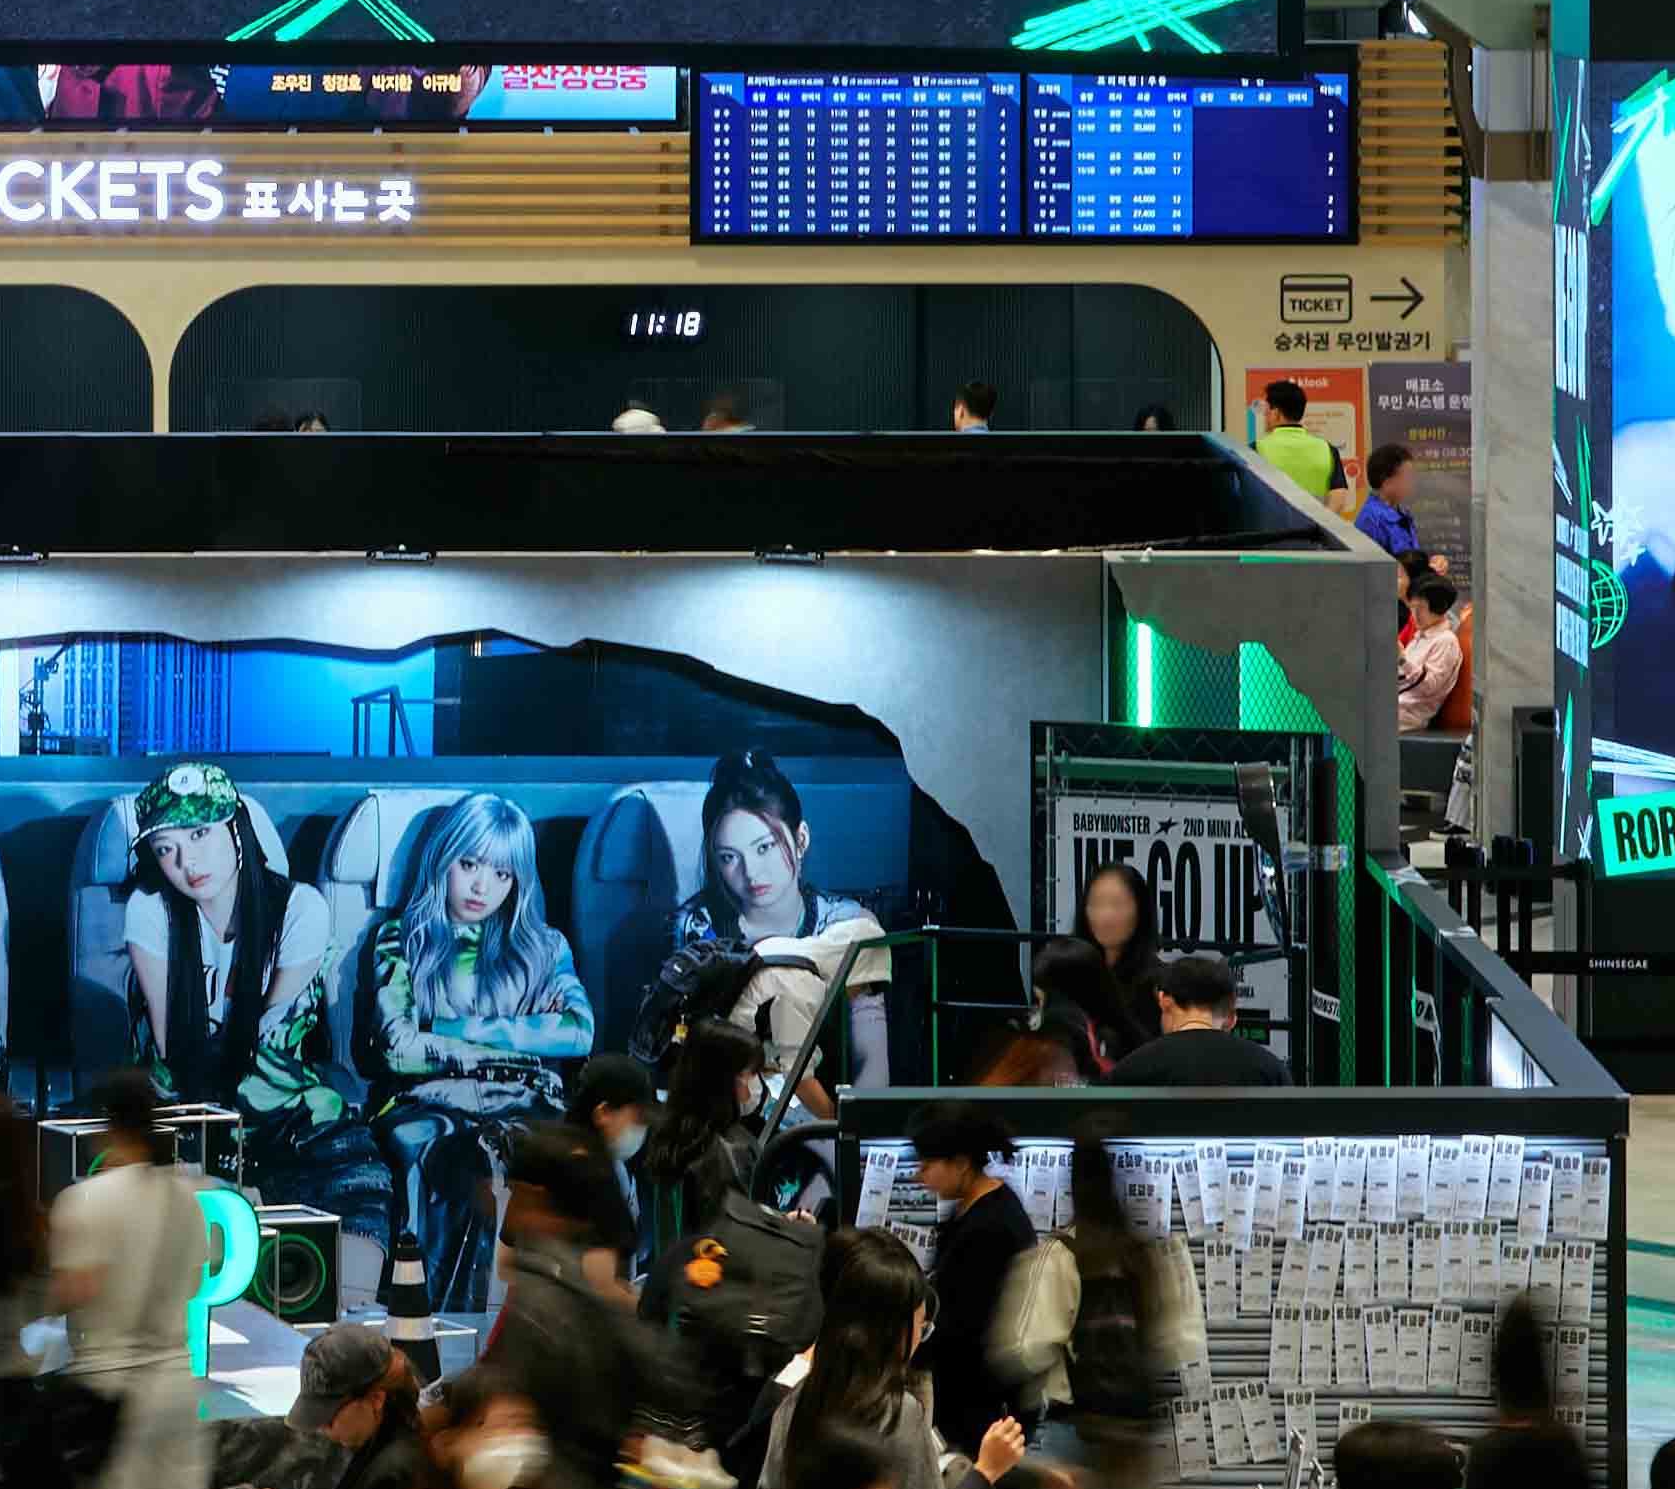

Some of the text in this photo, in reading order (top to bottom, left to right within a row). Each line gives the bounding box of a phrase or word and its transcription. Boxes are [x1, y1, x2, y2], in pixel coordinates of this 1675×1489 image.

[242, 183, 281, 219] 표
[1289, 298, 1344, 312] TICKET
[630, 311, 701, 337] 11:18
[1274, 331, 1430, 352] 승차권 무인발권기
[1404, 378, 1445, 393] 매표소
[1073, 812, 1231, 839] BABYMONSTER 2ND MINI
[1588, 959, 1649, 970] SHINSEGAE
